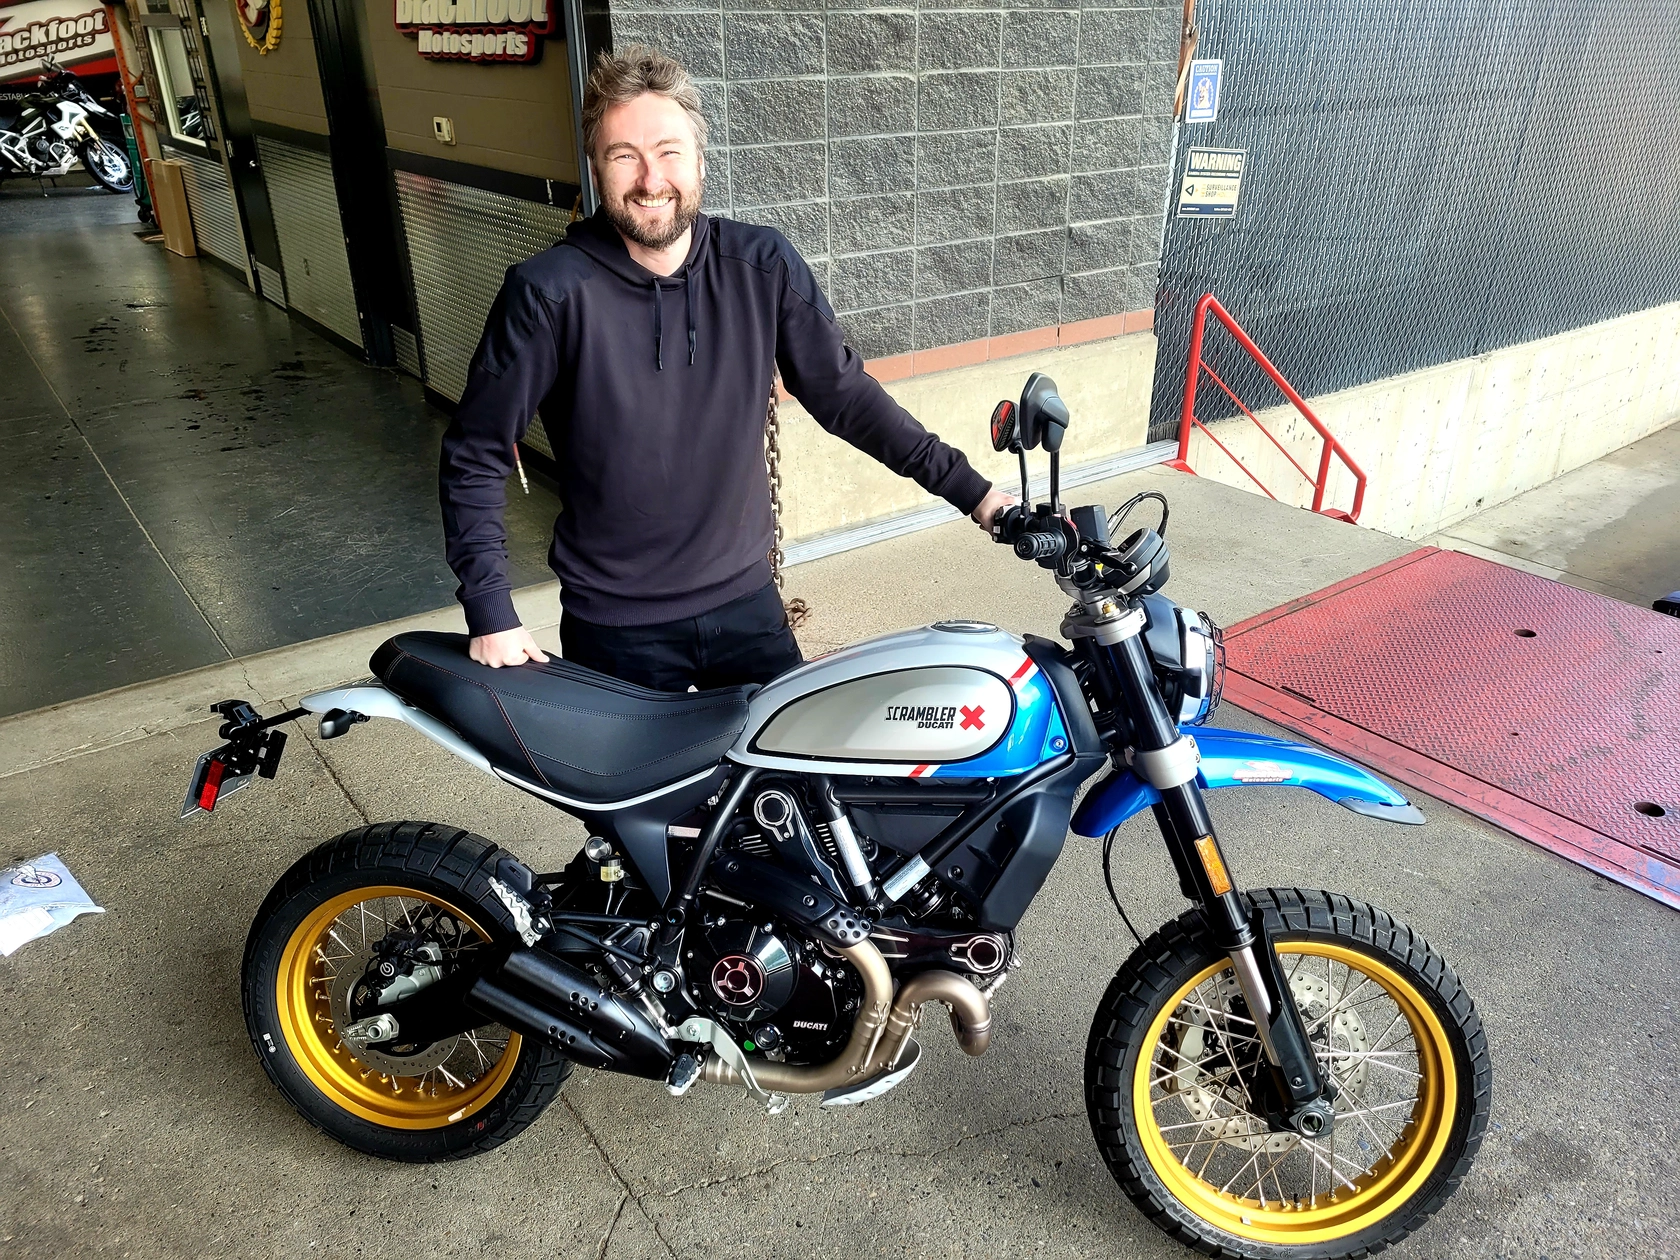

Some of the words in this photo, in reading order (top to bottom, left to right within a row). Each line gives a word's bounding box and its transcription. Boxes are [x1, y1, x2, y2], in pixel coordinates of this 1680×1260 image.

[418, 30, 528, 56] Motosports
[1190, 152, 1242, 171] WARNING
[885, 706, 957, 721] SCRAMBLER
[917, 721, 954, 729] DUCATI
[254, 937, 276, 1018] PIRELLI
[793, 1020, 828, 1031] DUCATI
